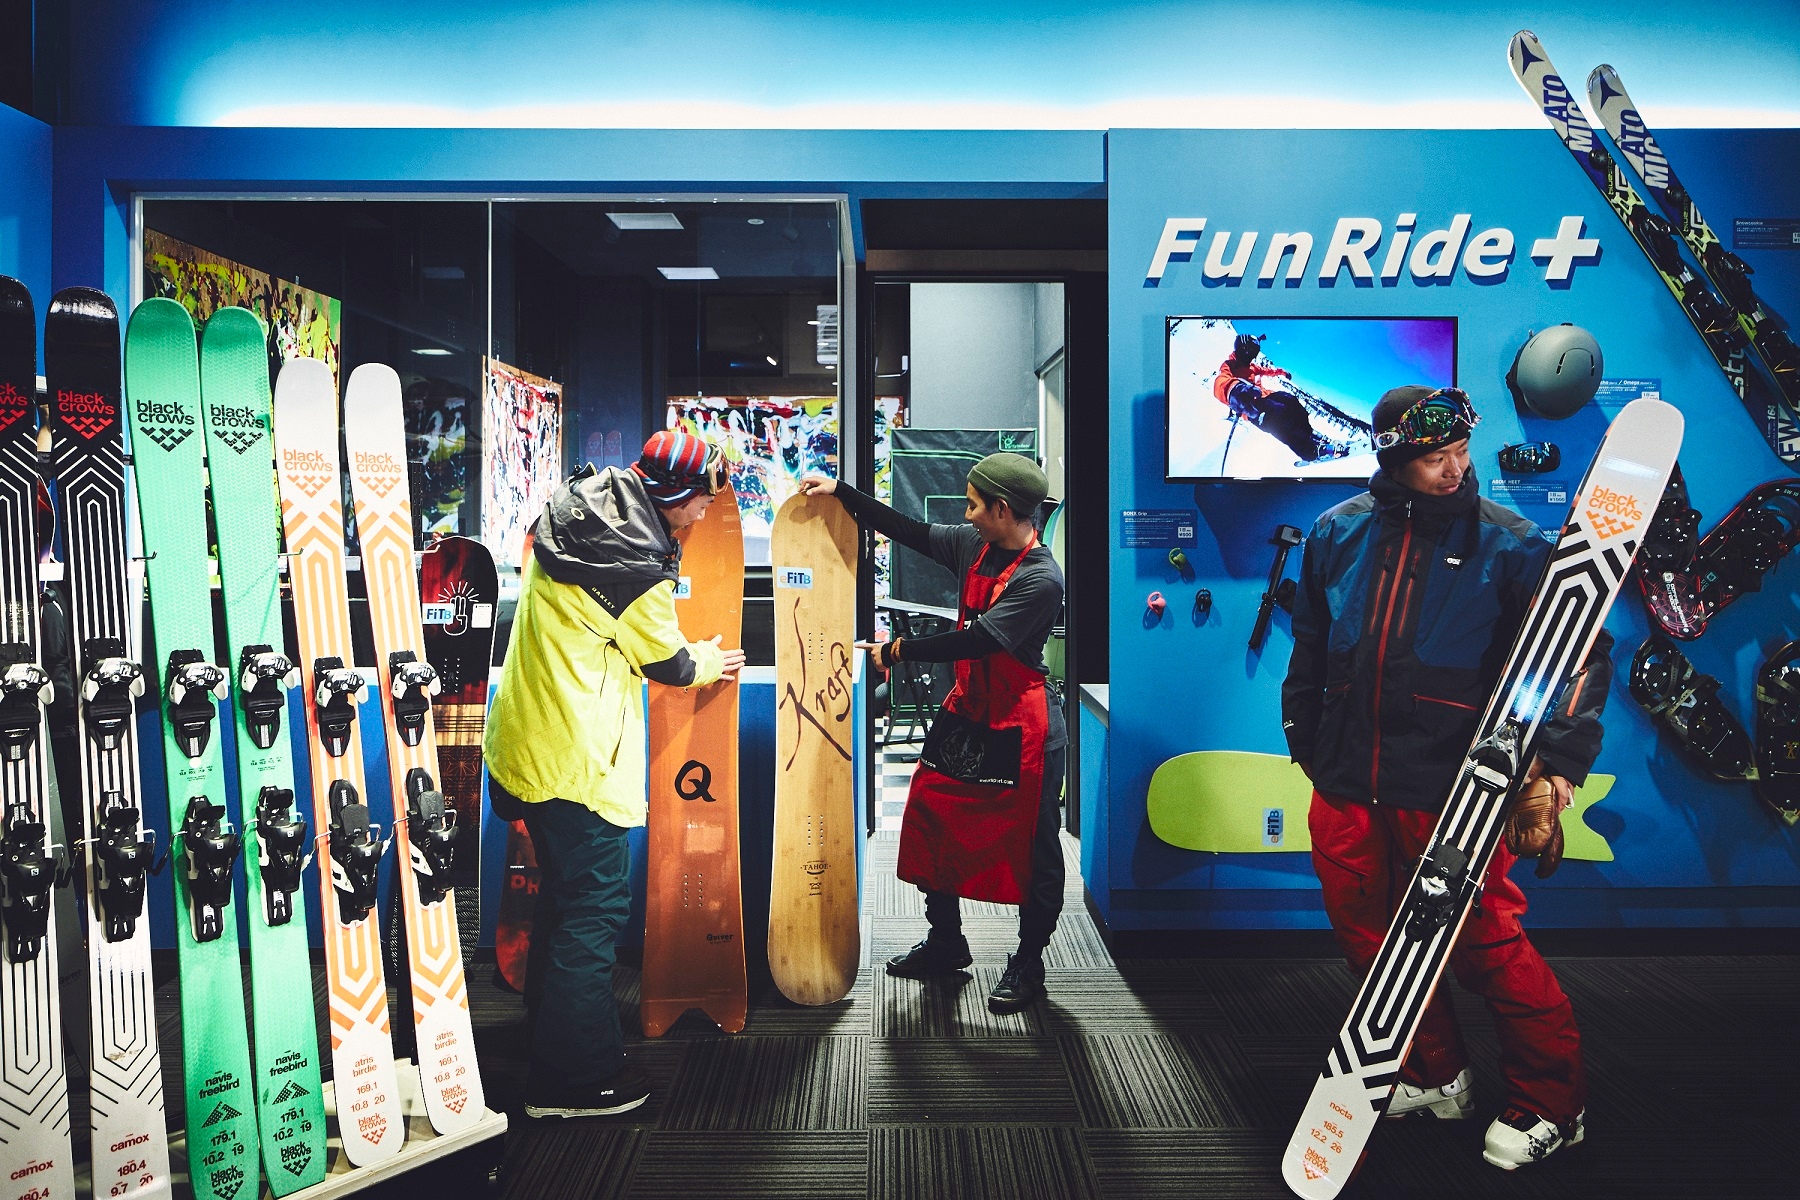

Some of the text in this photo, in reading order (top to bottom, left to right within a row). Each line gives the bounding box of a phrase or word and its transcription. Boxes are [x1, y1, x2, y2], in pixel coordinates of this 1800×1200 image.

[58, 390, 104, 405] black
[58, 402, 115, 415] crows
[137, 399, 184, 414] black
[210, 404, 255, 418] black
[137, 412, 195, 426] crows
[211, 416, 266, 429] crows
[283, 448, 324, 462] black
[355, 452, 393, 464] black
[284, 460, 333, 472] crows
[356, 462, 402, 473] crows
[1592, 485, 1638, 509] black
[1589, 497, 1643, 521] crows
[591, 586, 615, 609] OAKLEY
[706, 933, 734, 941] Quiver
[436, 1030, 454, 1042] atris
[434, 1038, 457, 1050] birdie
[276, 1052, 301, 1066] navis
[354, 1056, 374, 1068] atris
[439, 1055, 458, 1067] 169.1
[270, 1058, 308, 1077] freebird
[353, 1063, 377, 1078] birdie
[206, 1072, 233, 1087] navis
[434, 1067, 466, 1084] 10.8 20
[199, 1078, 240, 1099] freebird
[357, 1082, 378, 1095] 169.1
[441, 1084, 462, 1097] black
[443, 1088, 467, 1102] crows
[351, 1094, 386, 1113] 10.8 20
[1329, 1101, 1353, 1121] nocta
[281, 1108, 305, 1123] 179.1
[358, 1112, 381, 1126] black
[273, 1121, 312, 1142] 10.2 19
[360, 1118, 387, 1133] crows
[1323, 1120, 1344, 1139] 185.5
[110, 1134, 150, 1152] camox
[211, 1130, 236, 1147] 179.1
[1310, 1128, 1342, 1154] 12.2 26
[203, 1145, 244, 1167] 10.2 19
[281, 1141, 306, 1157] black
[282, 1147, 312, 1163] crows
[1306, 1147, 1328, 1166] black
[10, 1160, 54, 1180] camox
[117, 1159, 147, 1177] 180.4
[1304, 1154, 1330, 1174] crows
[211, 1165, 238, 1181] black
[212, 1170, 244, 1188] crows
[110, 1182, 128, 1197] 9.7
